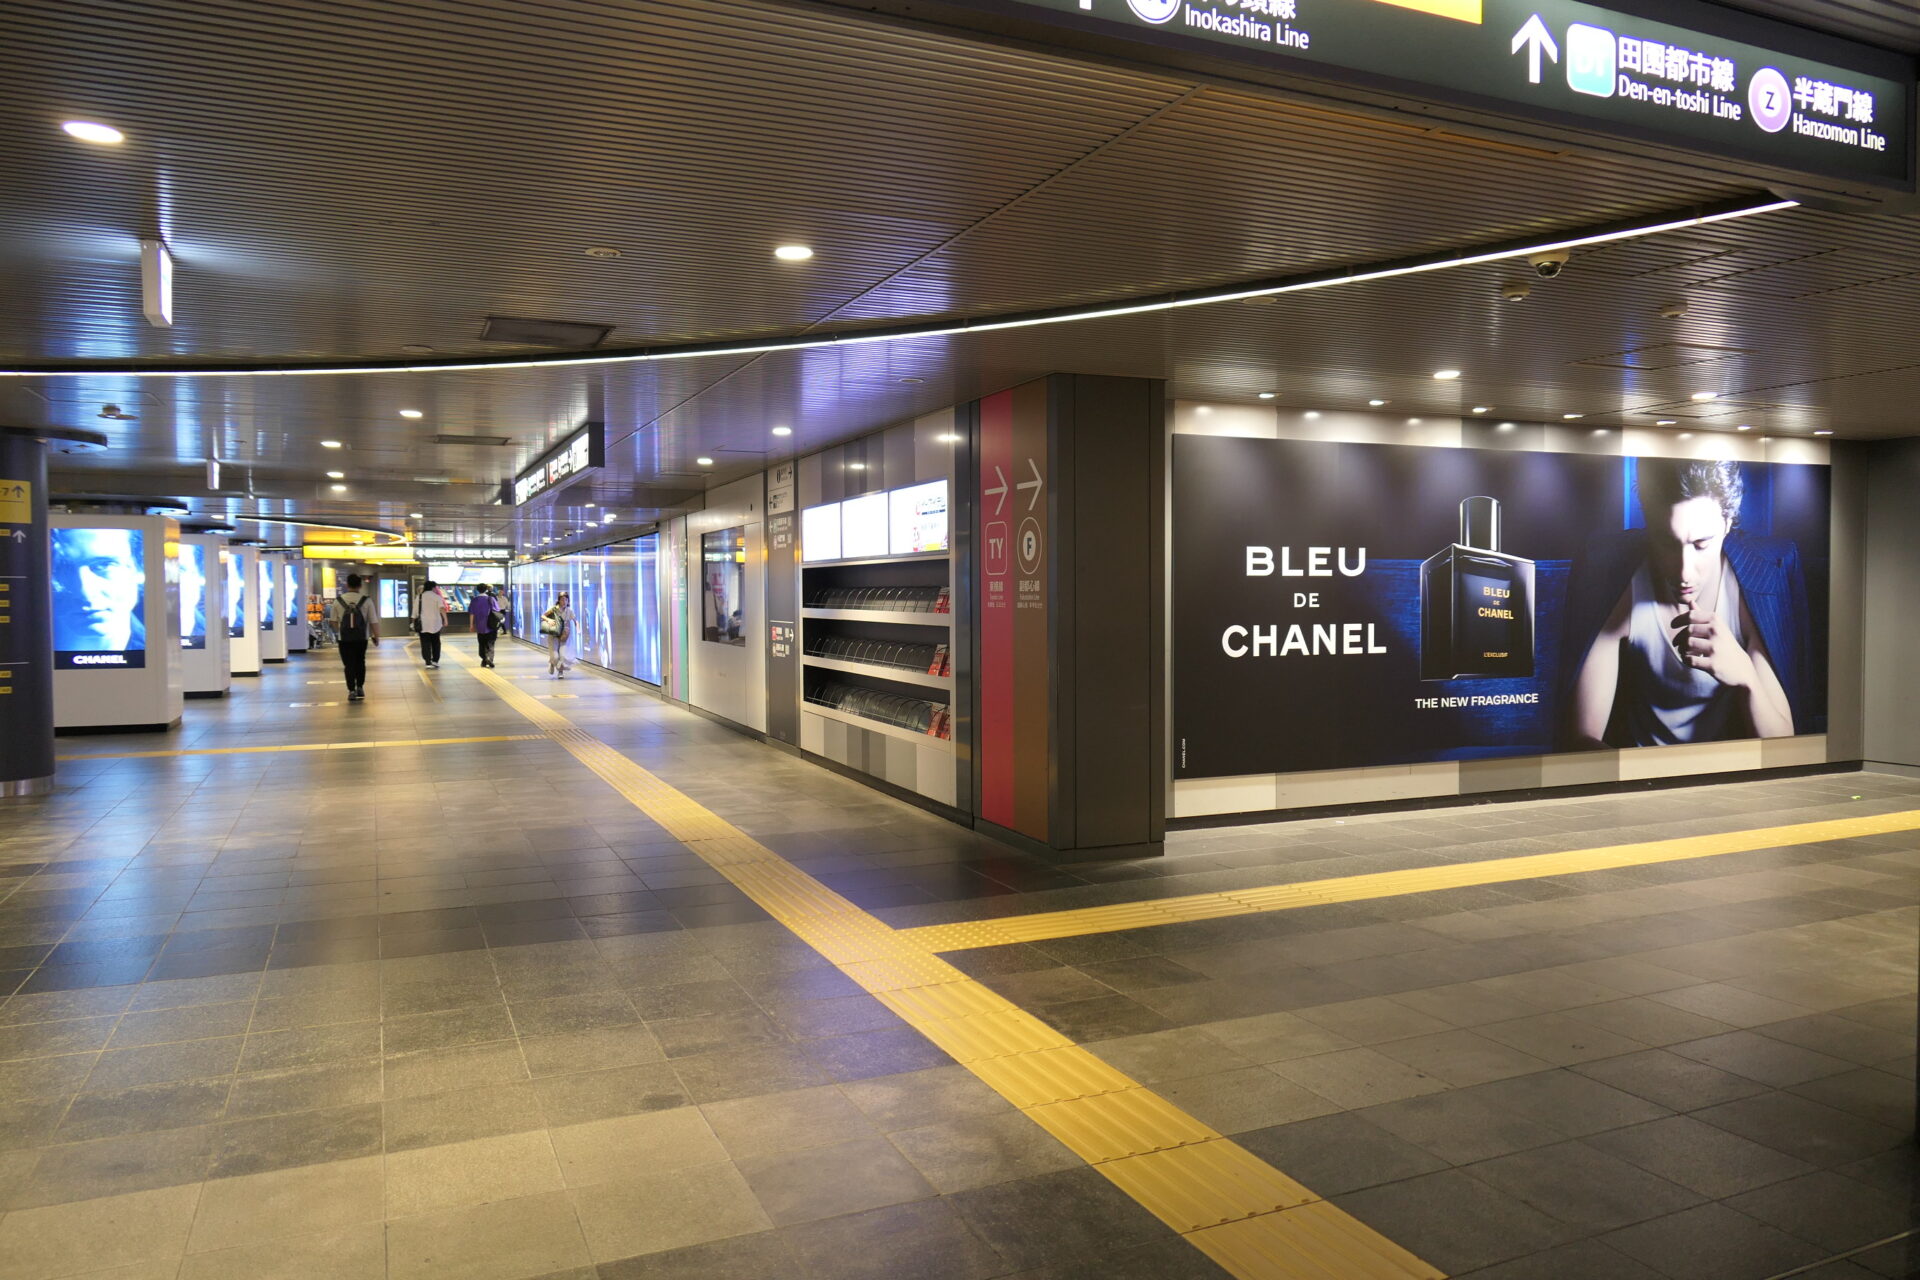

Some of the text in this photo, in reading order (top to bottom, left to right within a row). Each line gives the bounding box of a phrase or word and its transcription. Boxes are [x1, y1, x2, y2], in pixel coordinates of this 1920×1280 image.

[1185, 4, 1310, 49] Inokashira Line
[1618, 36, 1735, 92] 田園都市線
[1618, 75, 1742, 121] Den-en-toshi Line
[1765, 90, 1775, 110] Z
[1793, 77, 1873, 123] 半蔵門線
[1793, 112, 1886, 151] Hanzomon Line
[988, 538, 1004, 560] TY
[1026, 537, 1033, 556] F
[1246, 545, 1366, 577] BLEU
[1293, 592, 1320, 608] DE
[1483, 586, 1511, 599] BLEU
[1478, 607, 1514, 620] CHANEL
[1221, 623, 1387, 658] CHANEL
[73, 654, 128, 665] CHANEL
[1415, 693, 1539, 709] THE NEW FRAGRANCE
